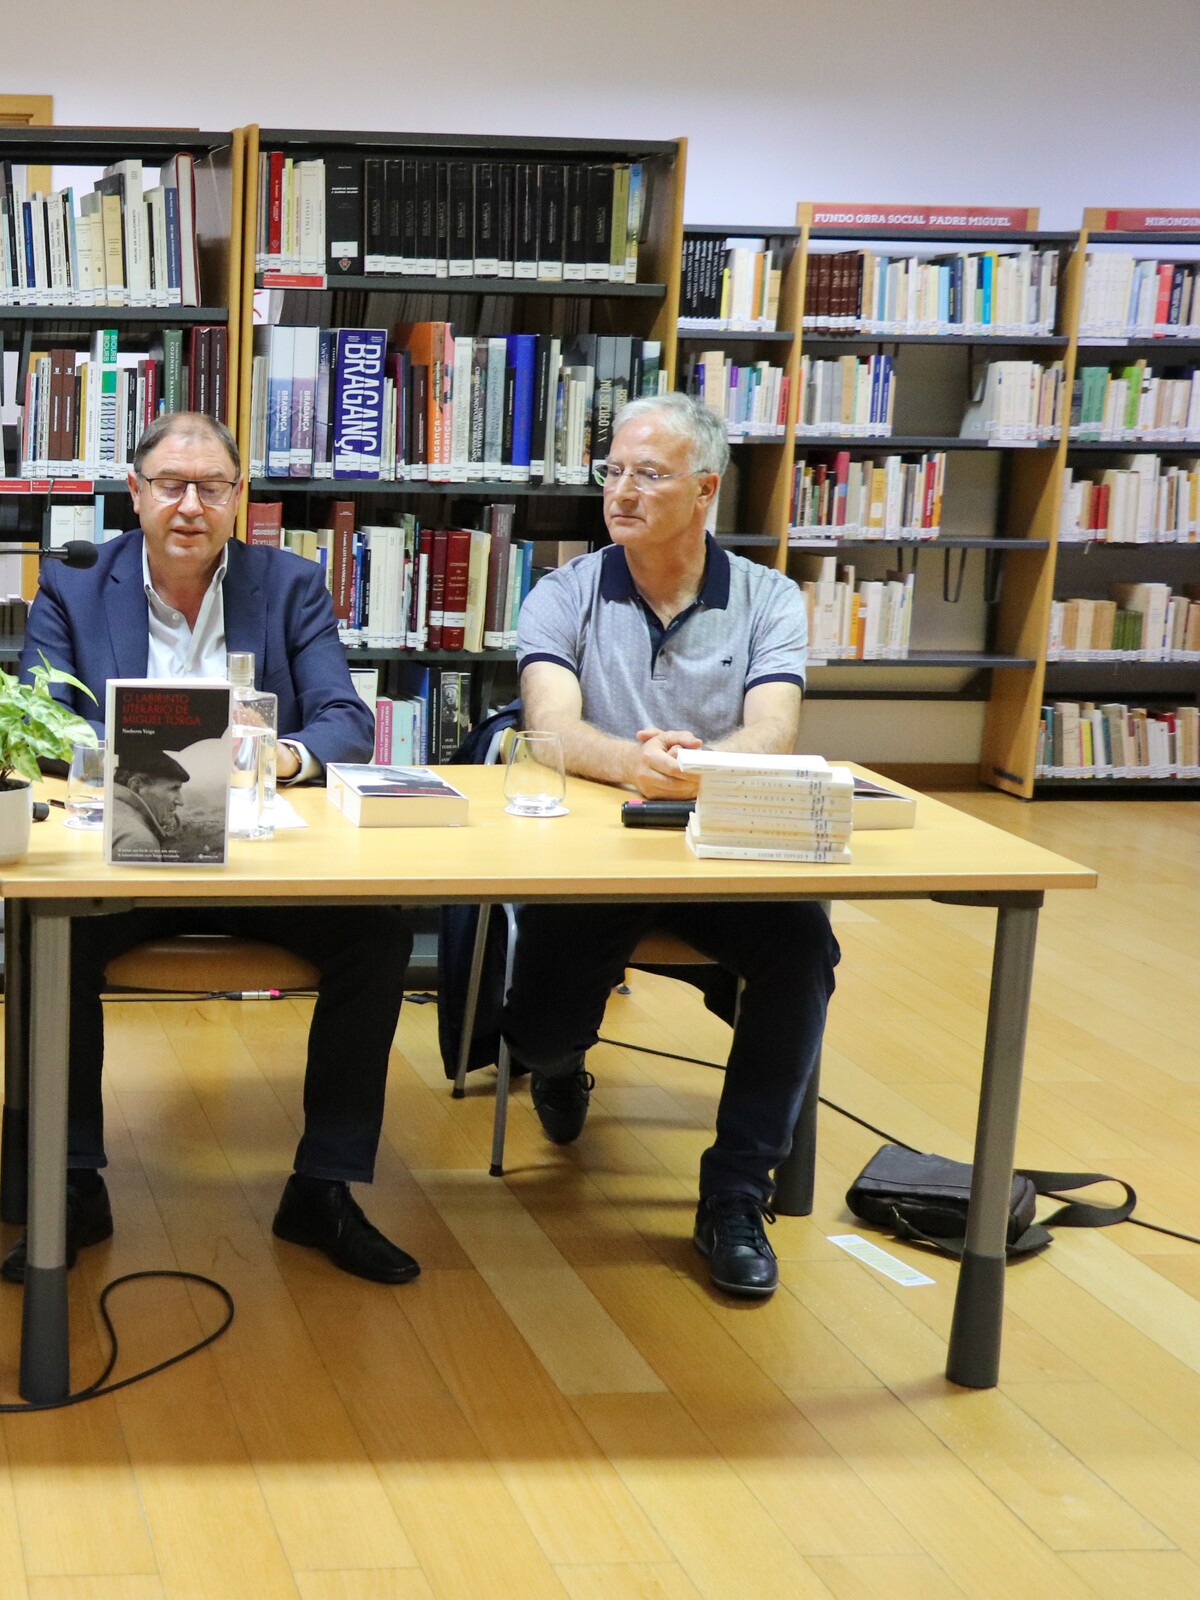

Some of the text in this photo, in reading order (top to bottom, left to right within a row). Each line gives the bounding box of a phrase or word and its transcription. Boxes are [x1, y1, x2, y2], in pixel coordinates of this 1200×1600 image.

[814, 213, 1011, 227] FUNDO OBRA SOCIAL PADRE MIGUEL
[600, 380, 612, 392] NO
[279, 390, 289, 432] BRAGANÇA
[301, 390, 311, 432] BRAGANÇA
[433, 420, 442, 464] RAGANÇA
[123, 693, 189, 704] O LABIRINTO
[176, 704, 188, 715] DE
[122, 715, 201, 725] MIGUEL TORGA
